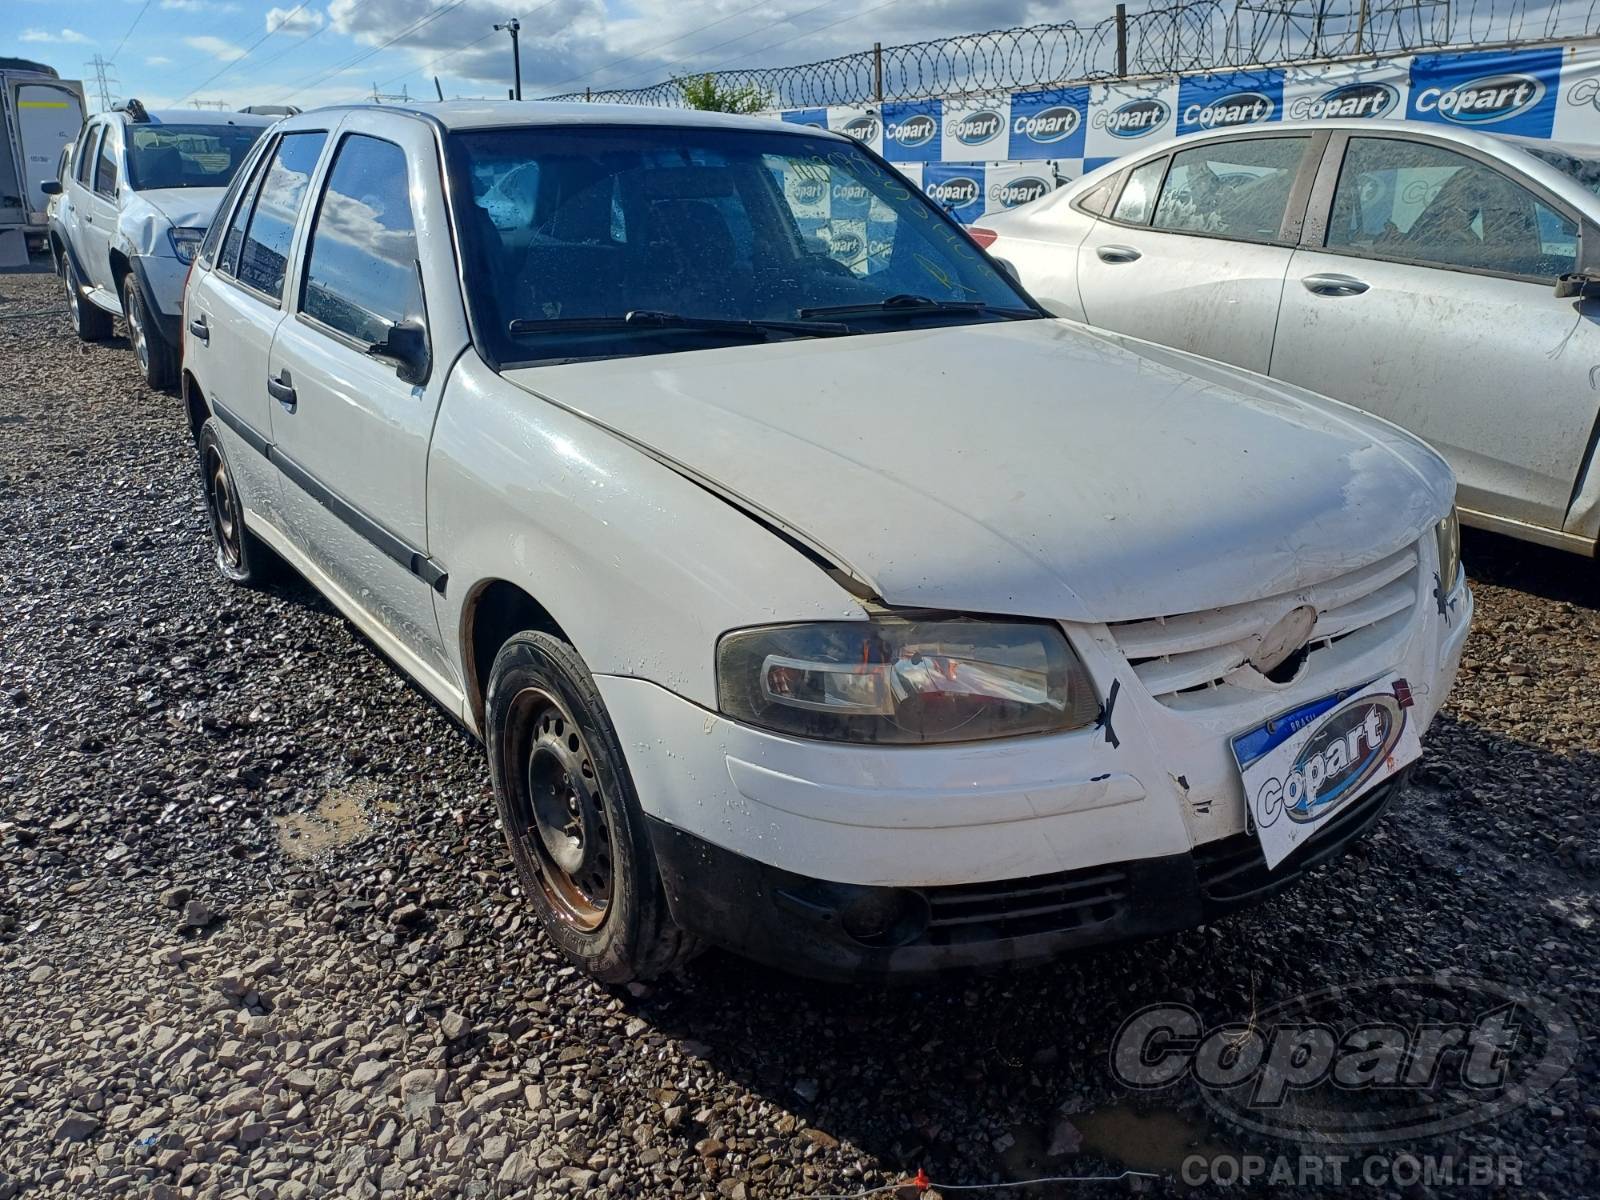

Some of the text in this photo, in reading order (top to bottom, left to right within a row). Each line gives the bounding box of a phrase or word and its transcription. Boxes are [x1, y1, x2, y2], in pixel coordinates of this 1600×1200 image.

[1289, 91, 1385, 119] Copart
[1415, 82, 1529, 115] Copart
[1014, 113, 1073, 136] Copart
[1092, 105, 1161, 131] Copart
[1183, 99, 1264, 126] Copart
[886, 120, 931, 140] Copart
[945, 117, 998, 140] Copart
[926, 183, 973, 202] Copart
[989, 184, 1043, 205] Copart
[1257, 704, 1384, 829] Copart
